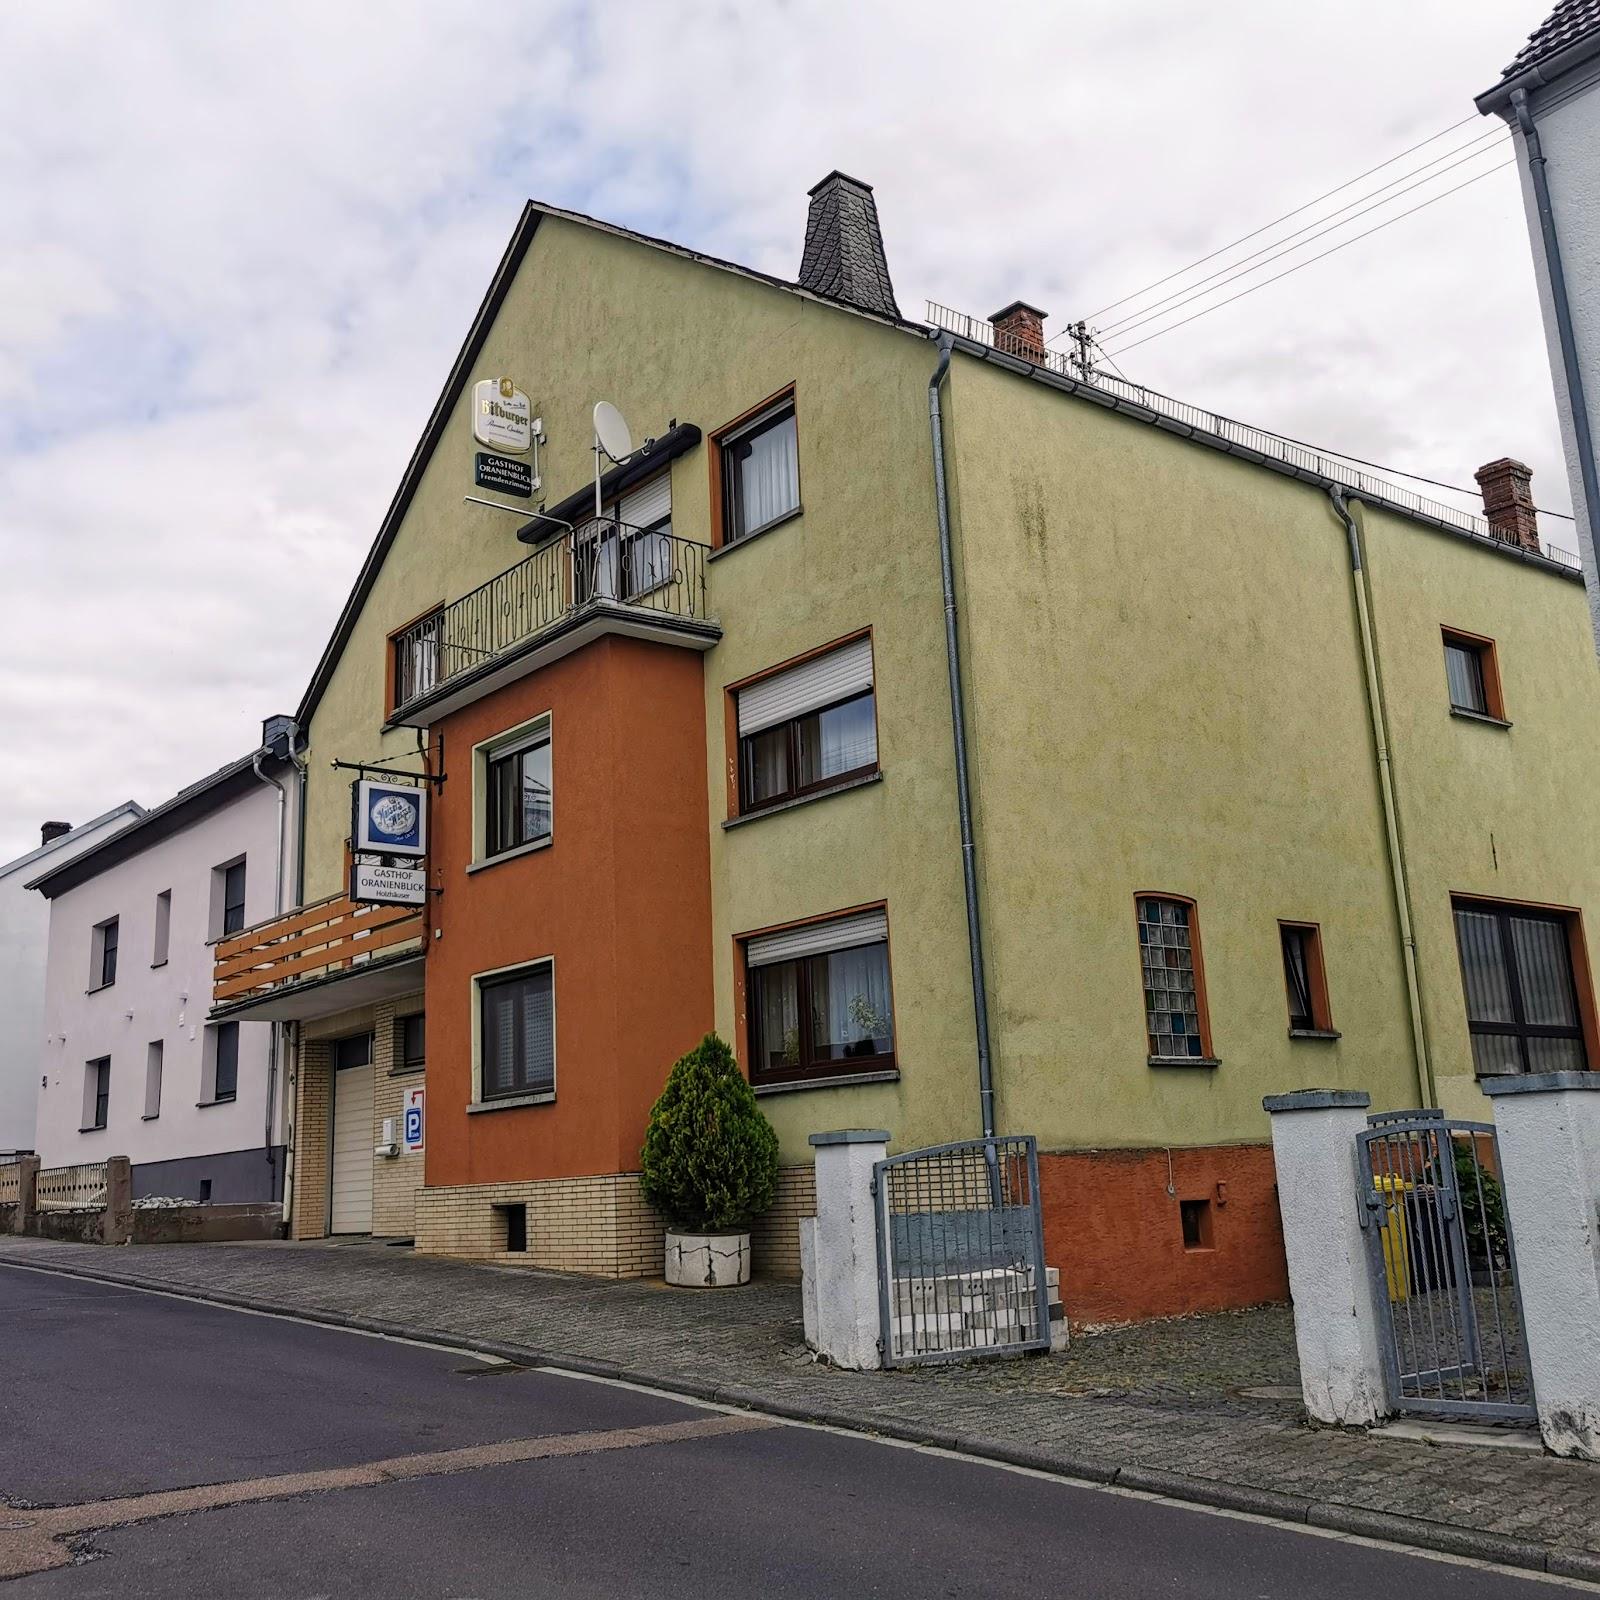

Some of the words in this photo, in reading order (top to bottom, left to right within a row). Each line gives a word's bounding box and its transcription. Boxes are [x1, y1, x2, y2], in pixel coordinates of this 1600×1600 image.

[482, 399, 528, 426] Bitburger
[479, 464, 531, 484] ORANIENBLICK
[487, 457, 524, 473] GASTHOF
[480, 472, 530, 491] Fremdenzimmer
[374, 868, 413, 880] GASTHOF
[361, 878, 425, 892] ORANIENBLICK
[408, 1113, 420, 1138] P
